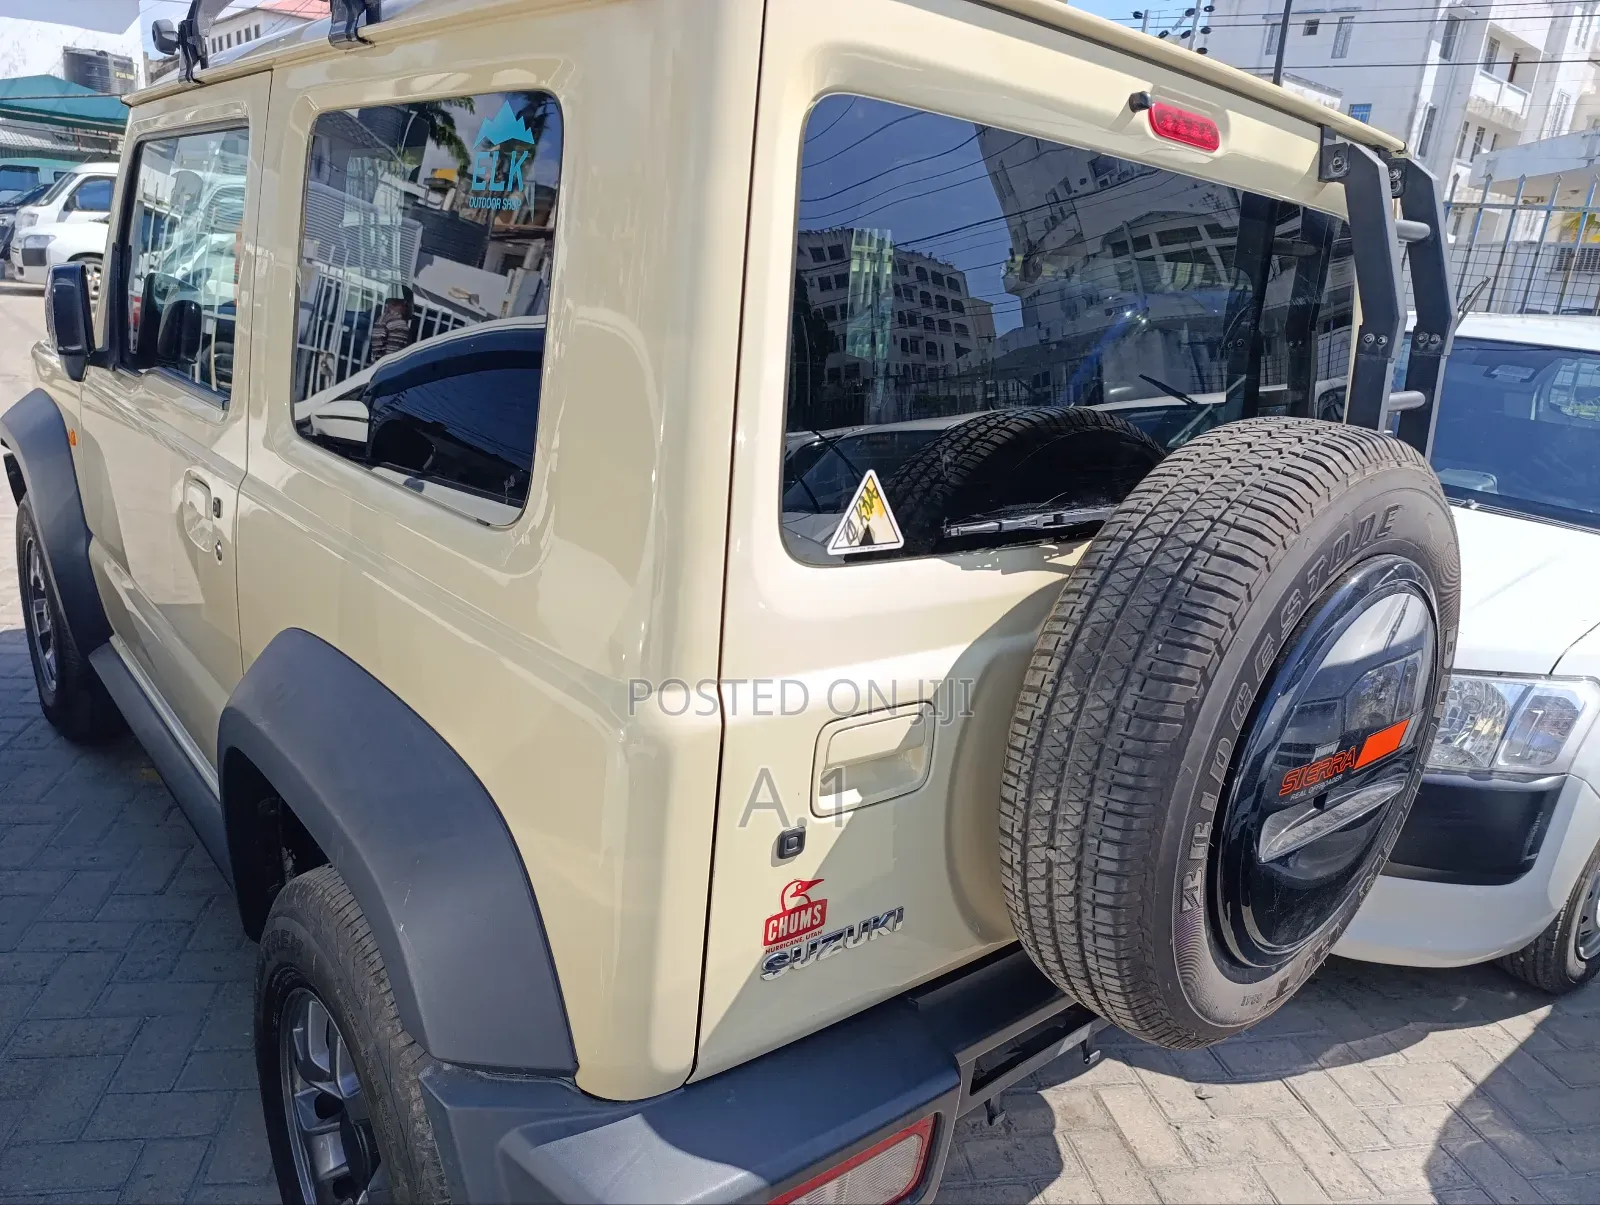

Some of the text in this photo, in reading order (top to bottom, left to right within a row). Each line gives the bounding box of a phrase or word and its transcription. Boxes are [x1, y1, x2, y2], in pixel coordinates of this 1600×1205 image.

[472, 151, 528, 192] ELK
[469, 197, 501, 209] OUTDOOR
[1279, 746, 1356, 796] SIERRA
[1290, 789, 1307, 801] REAL
[767, 904, 822, 942] CHUMS
[805, 930, 823, 941] UTAH
[760, 906, 904, 981] SUZUKI
